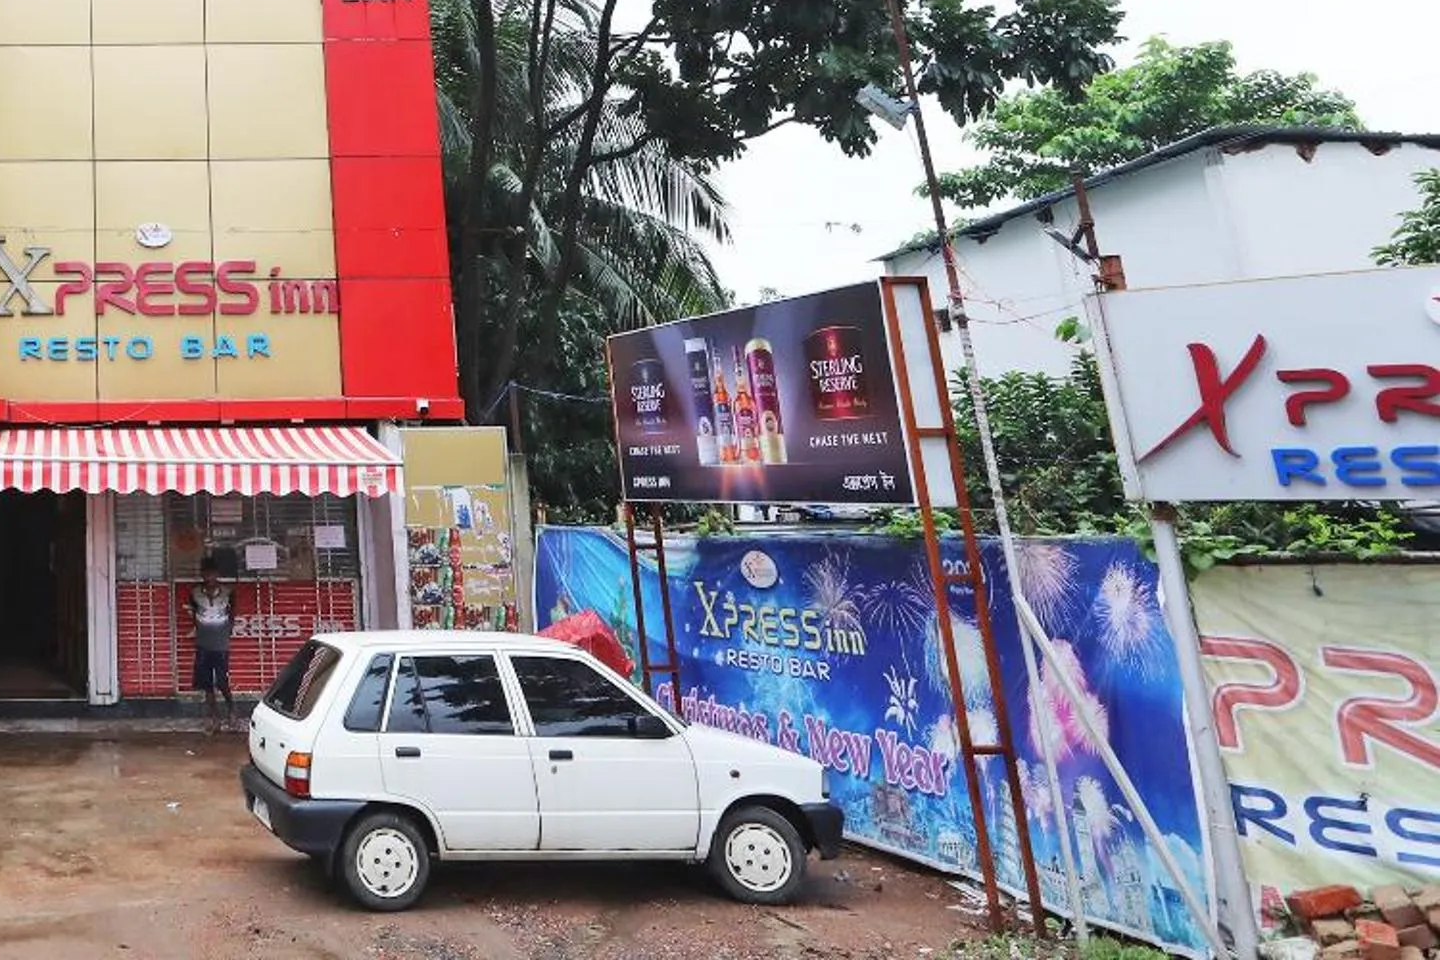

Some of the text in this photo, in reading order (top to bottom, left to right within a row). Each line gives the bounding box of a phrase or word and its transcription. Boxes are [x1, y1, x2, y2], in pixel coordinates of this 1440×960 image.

[268, 266, 340, 316] inn
[18, 331, 272, 362] RESTO BAR
[693, 581, 867, 657] XPRESS inn
[725, 648, 832, 681] RESTO BAR
[776, 708, 802, 755] &
[804, 713, 873, 779] New
[874, 728, 950, 796] Year
